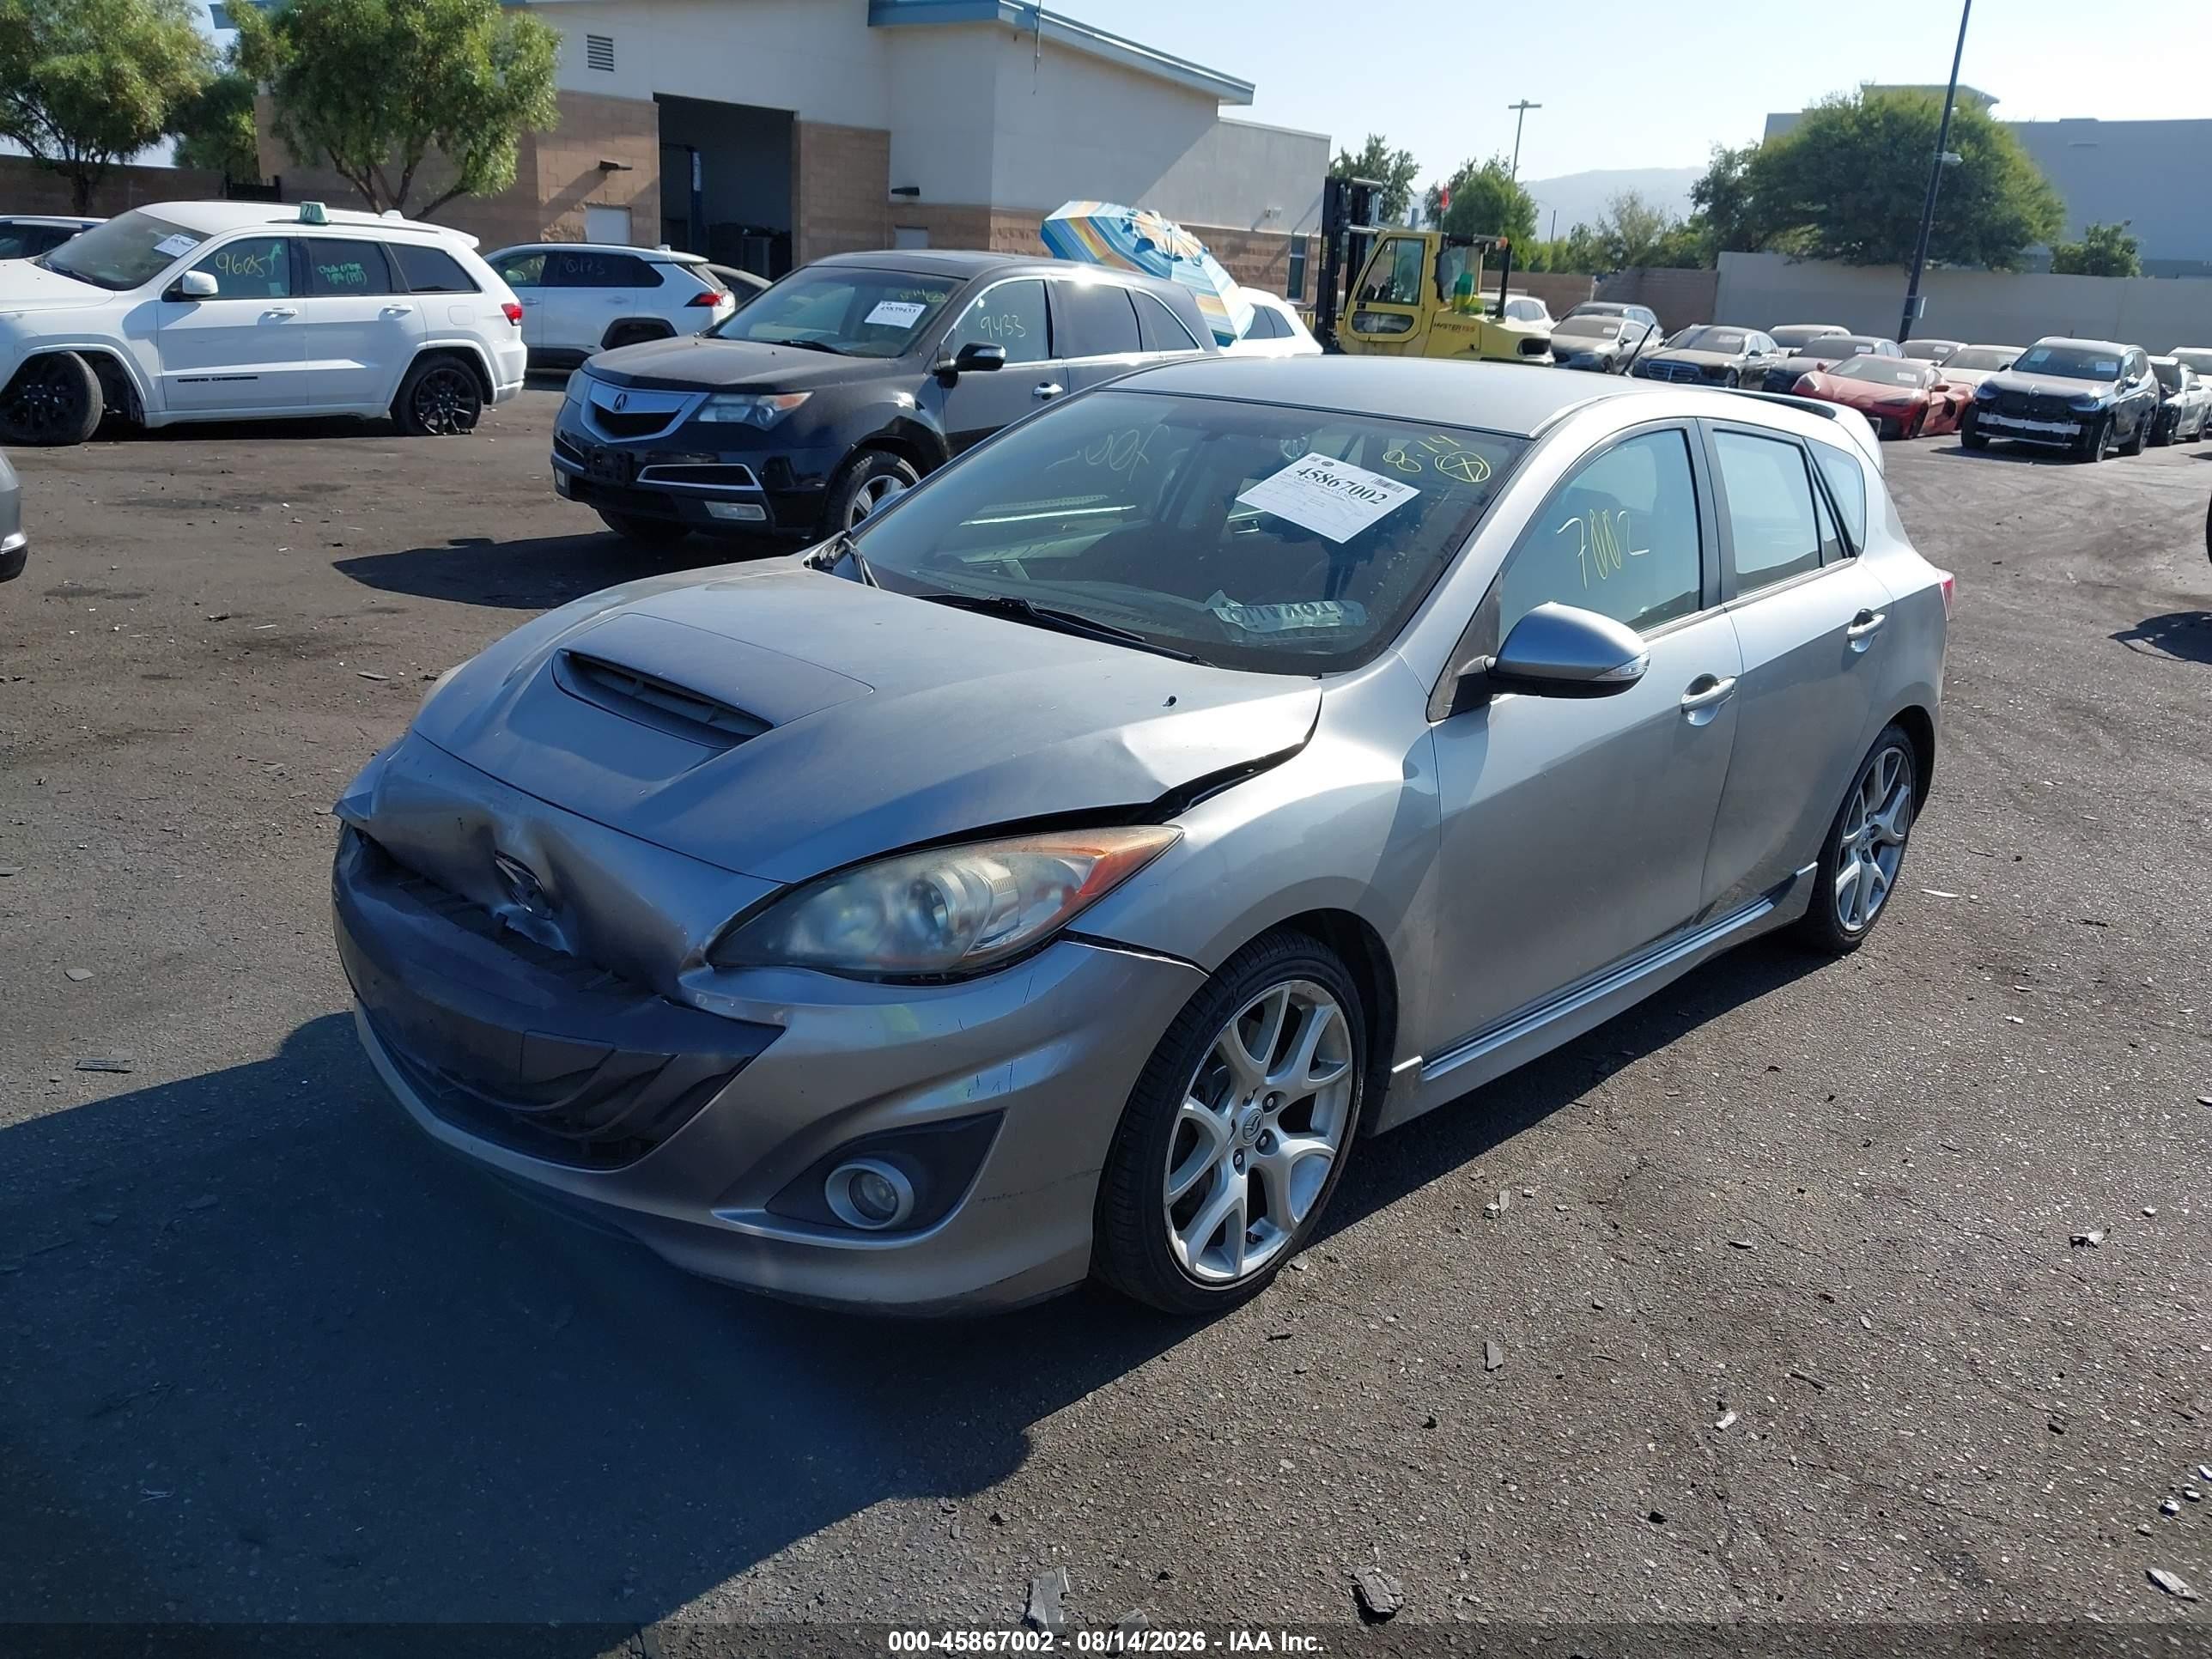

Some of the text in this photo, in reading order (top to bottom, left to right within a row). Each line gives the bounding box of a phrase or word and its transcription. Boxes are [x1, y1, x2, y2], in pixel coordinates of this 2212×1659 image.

[980, 313, 1026, 337] 9433
[1295, 466, 1389, 505] 45867002
[1555, 508, 1650, 591] 7002
